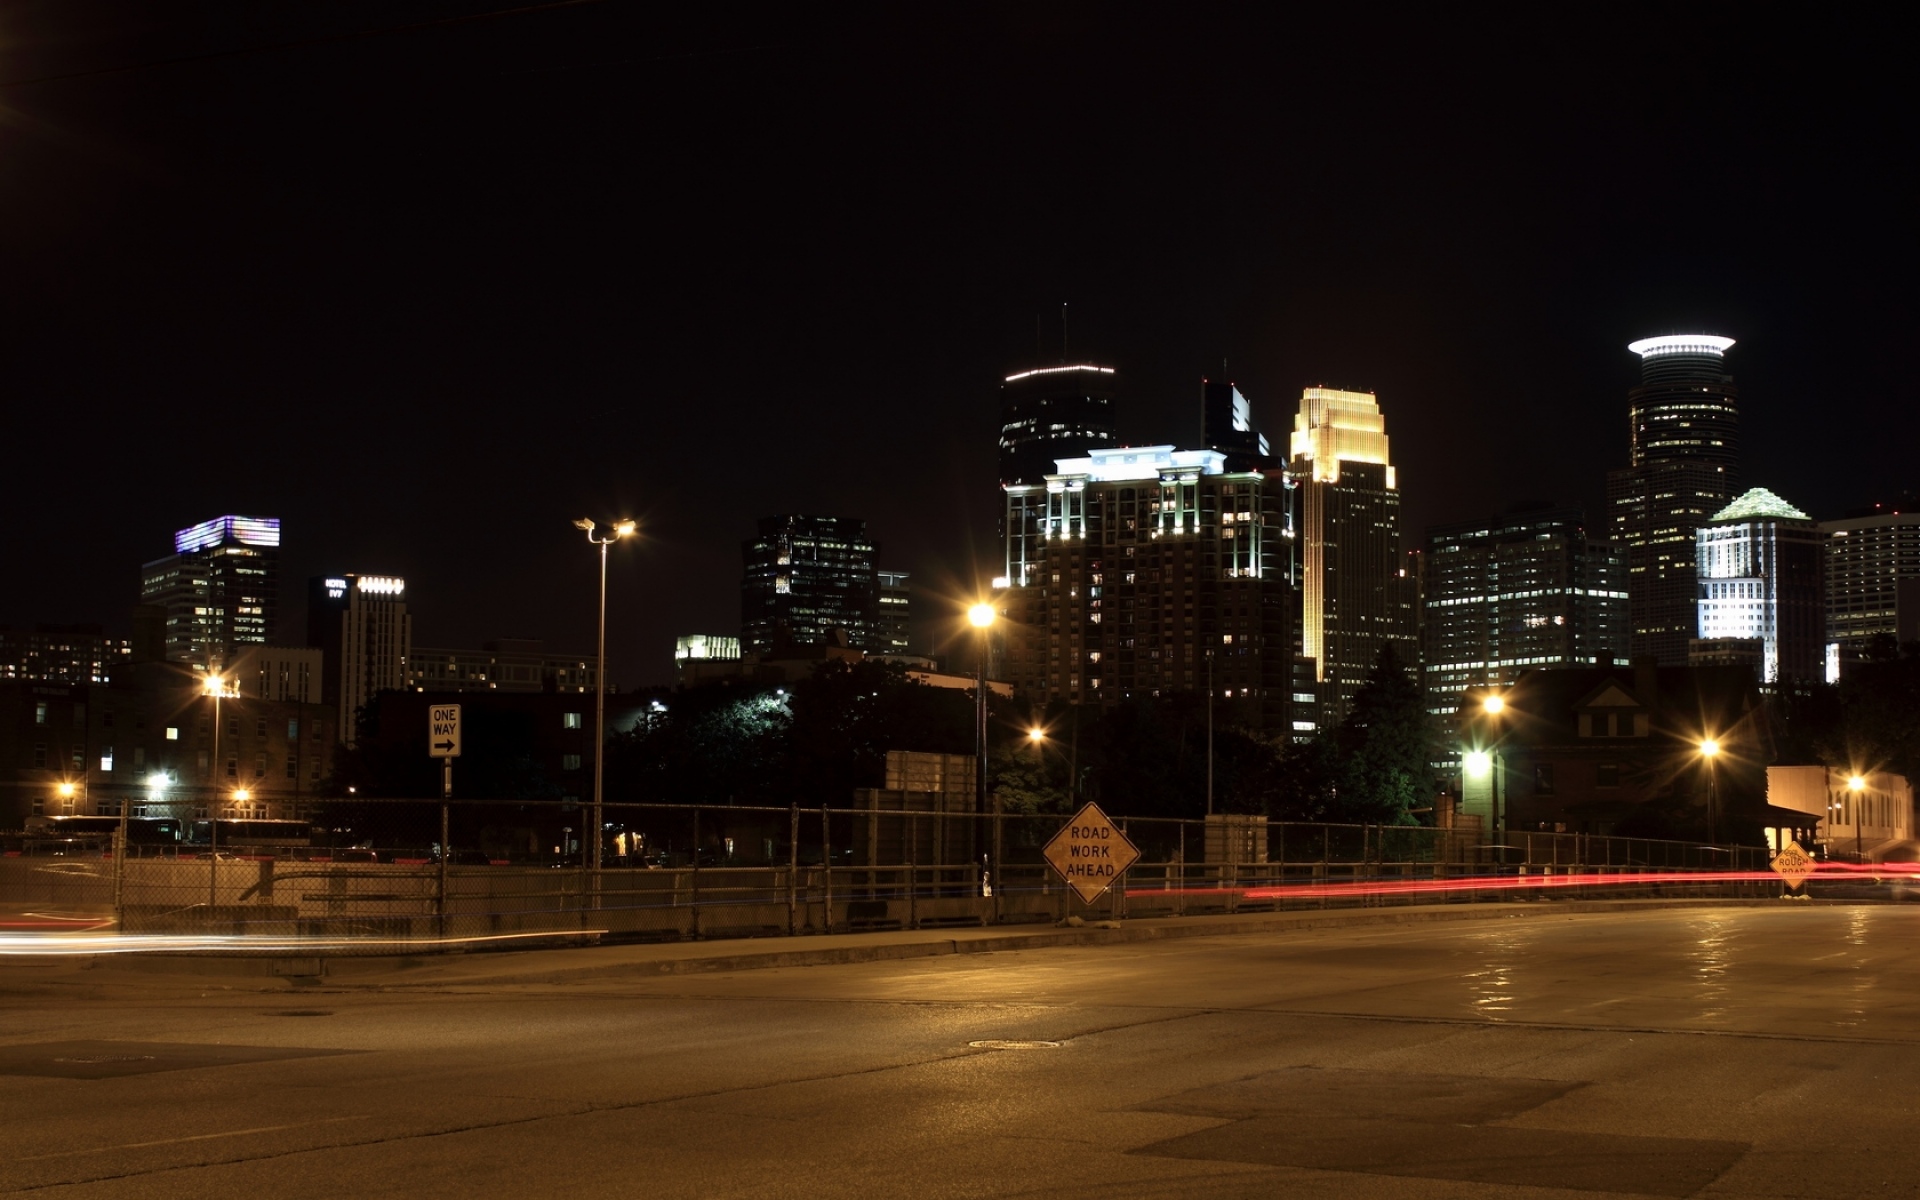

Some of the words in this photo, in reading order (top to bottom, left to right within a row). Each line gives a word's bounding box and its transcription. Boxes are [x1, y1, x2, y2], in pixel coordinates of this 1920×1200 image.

[325, 578, 347, 589] HOTEL
[329, 589, 343, 598] IVY
[434, 709, 456, 721] ONE
[433, 723, 456, 735] WAY
[1071, 826, 1110, 839] ROAD
[1070, 845, 1110, 858] WORK
[1779, 858, 1809, 867] ROUGH
[1066, 863, 1114, 877] AHEAD
